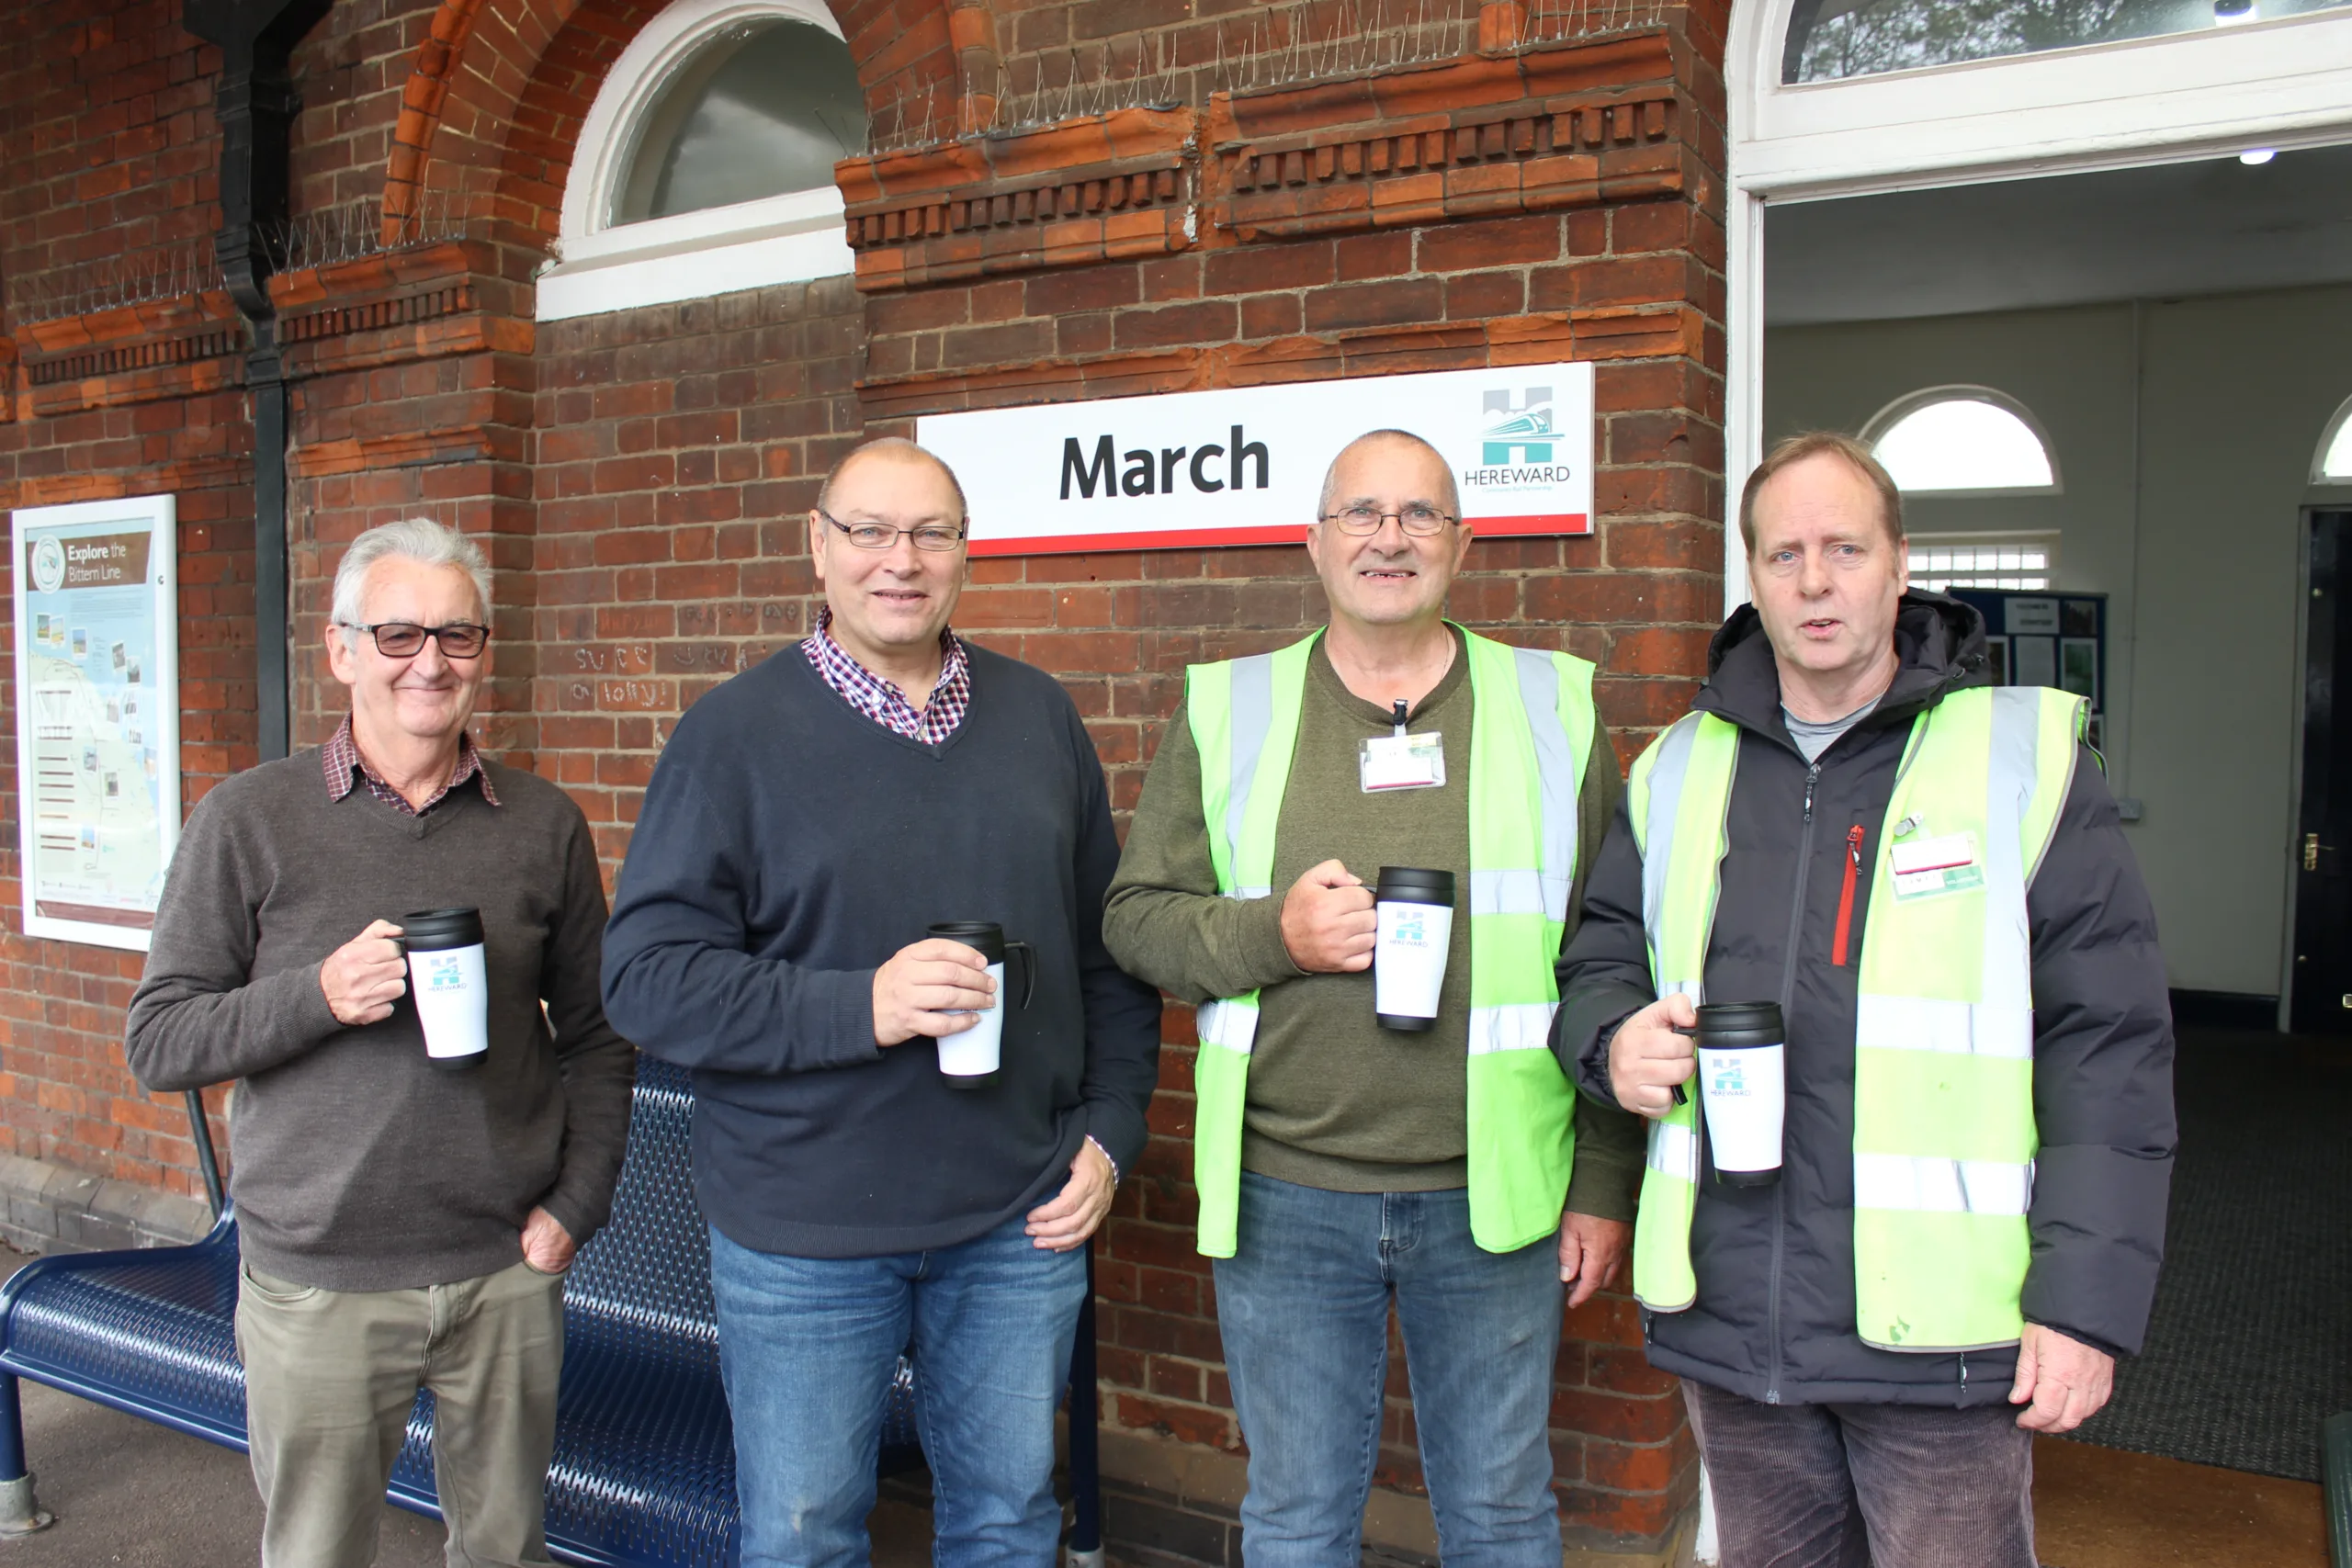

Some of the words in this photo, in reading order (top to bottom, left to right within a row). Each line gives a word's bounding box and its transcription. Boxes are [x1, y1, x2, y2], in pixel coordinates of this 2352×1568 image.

[1059, 424, 1270, 501] March
[1464, 466, 1570, 485] HEREWARD
[68, 544, 109, 565] Explore
[111, 542, 126, 558] the
[69, 566, 99, 582] Bittern
[101, 564, 120, 580] Line
[1389, 938, 1429, 948] HEREWARD
[428, 982, 467, 992] HEREWARD
